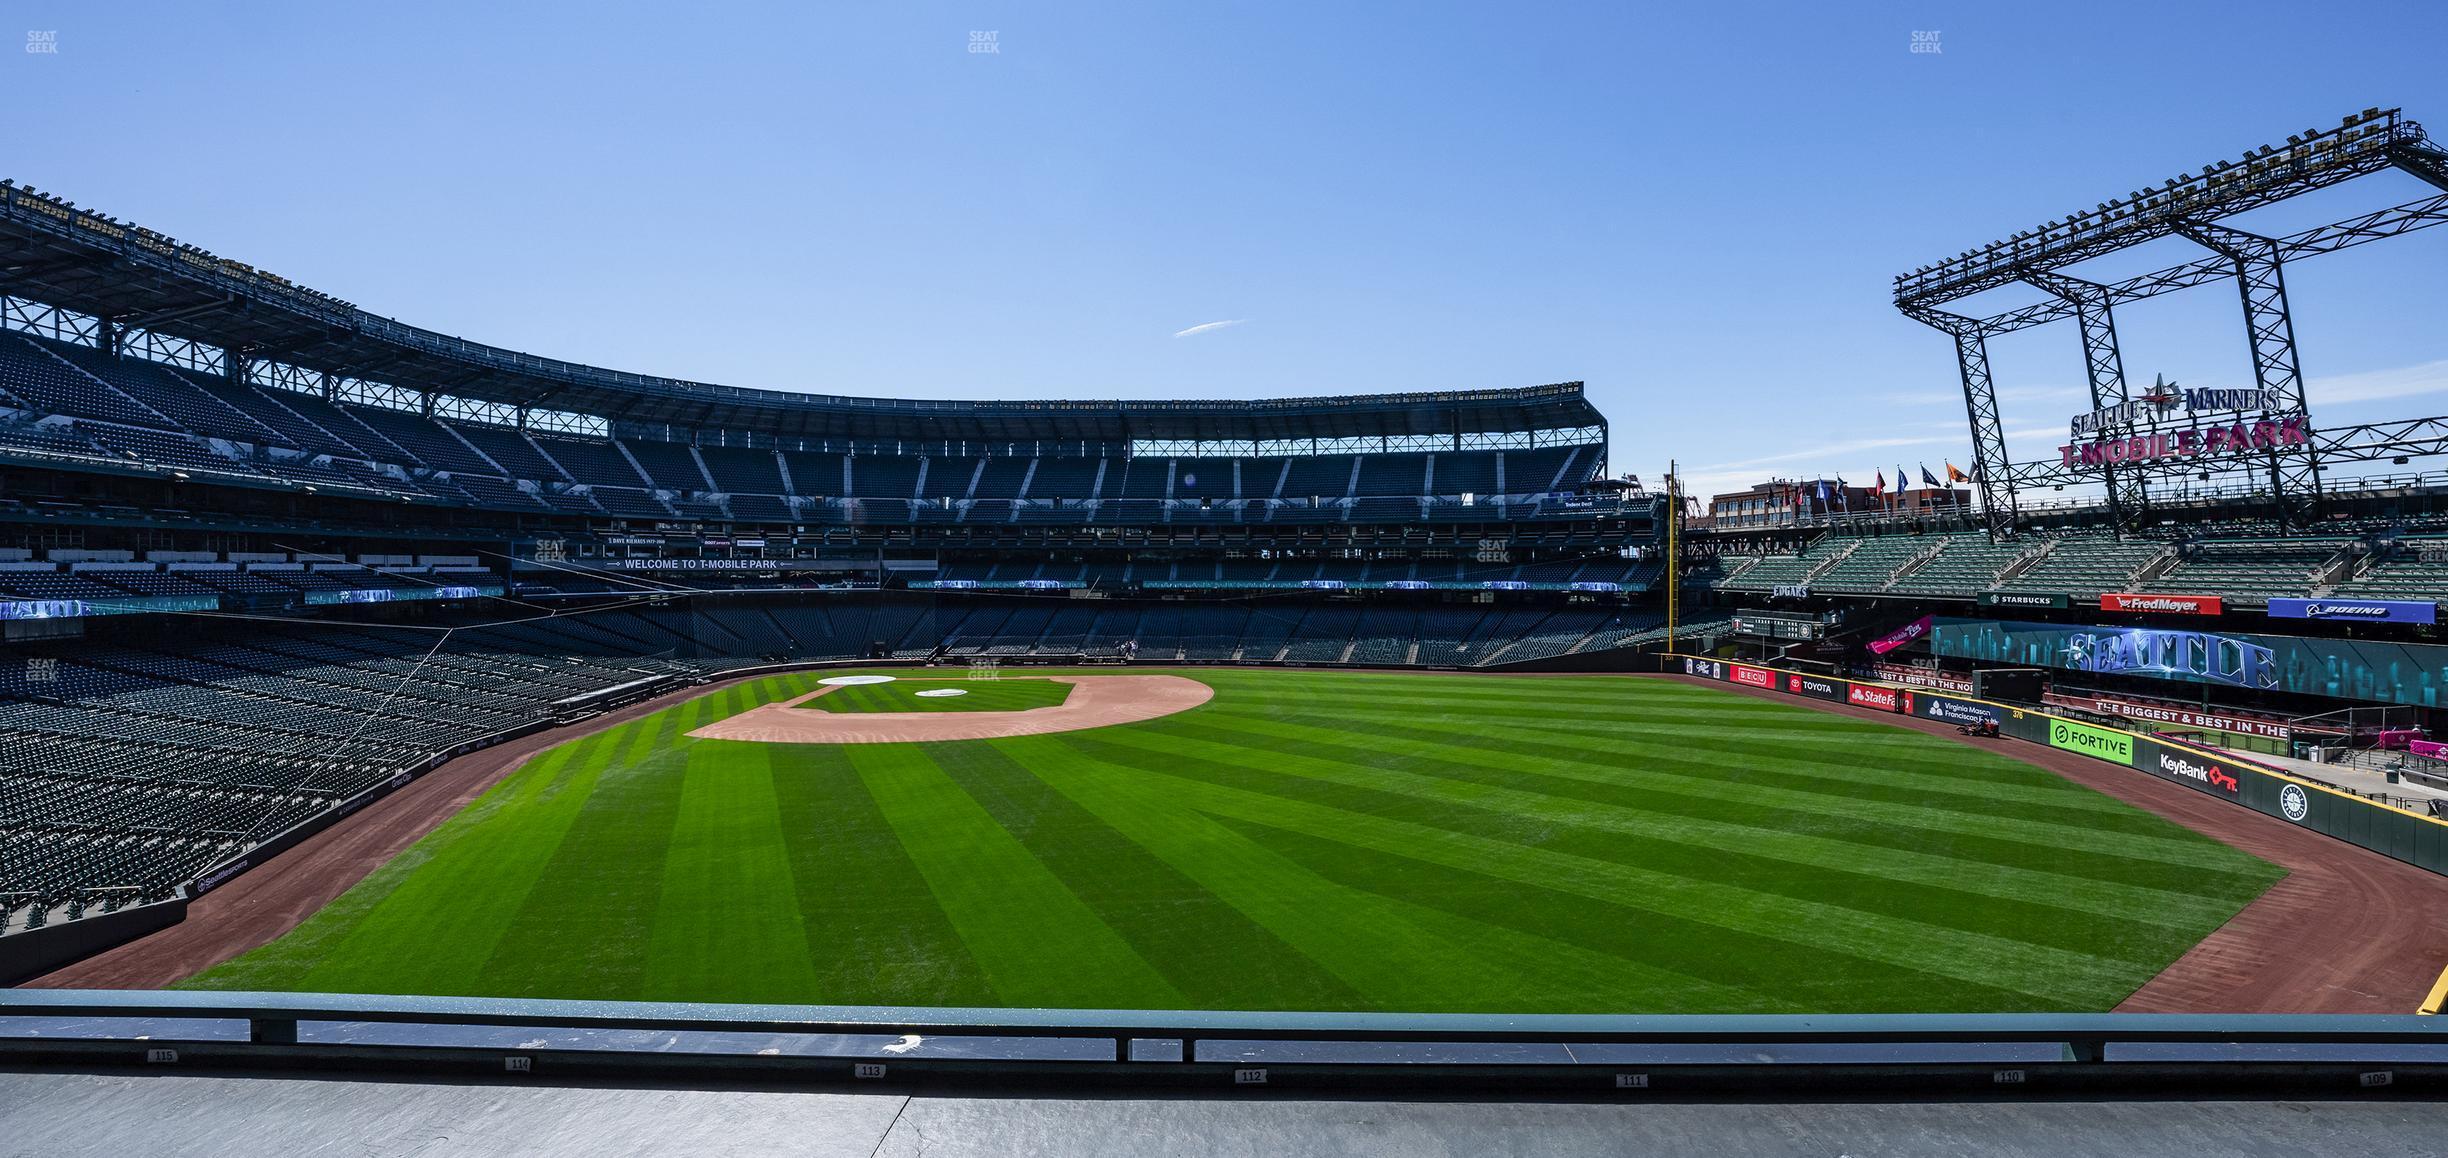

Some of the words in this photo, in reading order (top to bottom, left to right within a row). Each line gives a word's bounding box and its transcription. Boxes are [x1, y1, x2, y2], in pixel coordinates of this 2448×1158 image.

[2071, 401, 2143, 438] SEATTLE
[2184, 387, 2281, 412] MARINERS
[2058, 428, 2200, 468] T-MOBILE
[2206, 415, 2311, 454] PARK
[625, 560, 678, 569] WELCOME
[682, 560, 696, 569] TO
[700, 560, 747, 569] T-MOBILE
[749, 560, 777, 569] PARK
[2002, 596, 2051, 605] STARBUCKS
[2325, 606, 2387, 615] BOEING
[1740, 671, 1765, 683] BECU
[1906, 676, 1925, 685] BEST
[1927, 679, 1936, 687] IN
[1938, 680, 1955, 690] THE
[1803, 680, 1832, 694] TOYOTA
[1945, 703, 1968, 713] Virginia
[1969, 706, 1991, 716] Mason
[2096, 702, 2119, 713] THE
[2123, 706, 2178, 722] BIGGEST
[2181, 713, 2191, 724] &
[2196, 716, 2231, 730] BEST
[2236, 722, 2252, 732] IN
[2256, 724, 2288, 738] THE
[2072, 732, 2127, 756] FORTIVE
[2160, 754, 2208, 783] KeyBank
[156, 1050, 173, 1061] 115
[512, 1058, 528, 1070] 114
[863, 1065, 880, 1076] 113
[1242, 1071, 1261, 1082] 112
[2001, 1071, 2019, 1082] 110
[1624, 1075, 1641, 1086] 111
[2367, 1073, 2386, 1085] 109
